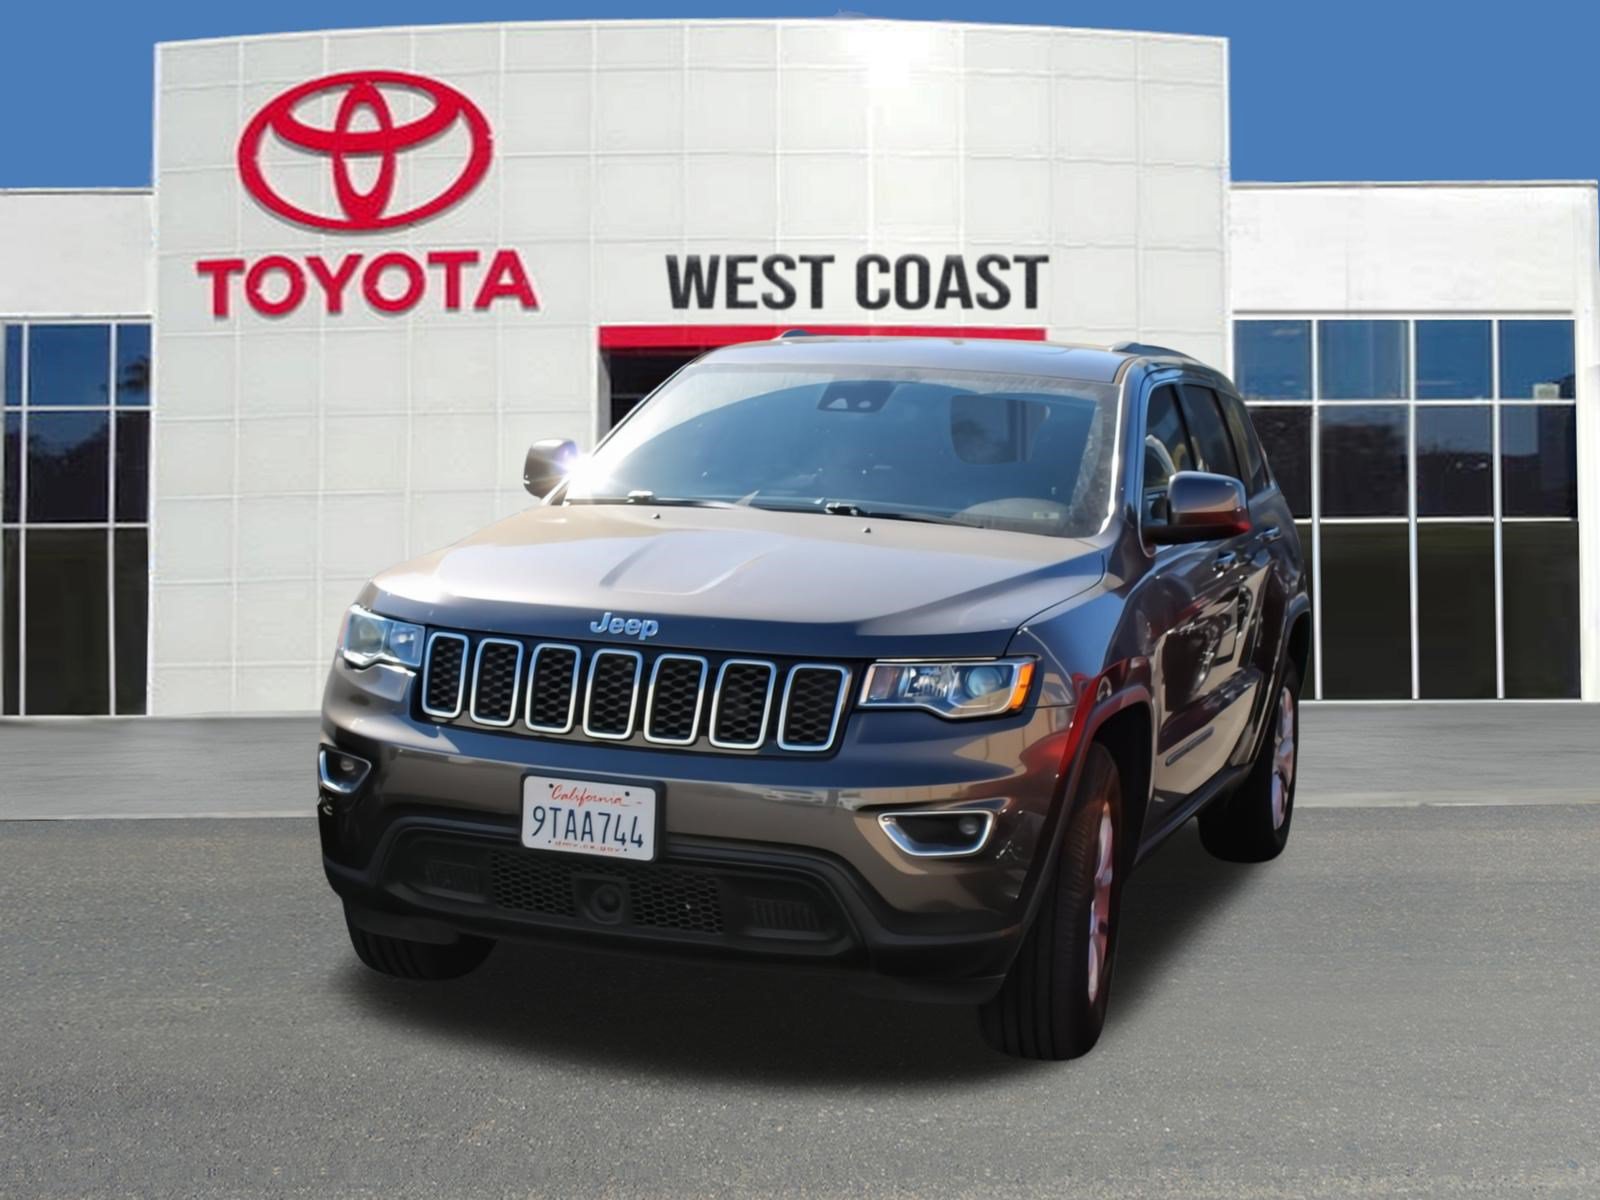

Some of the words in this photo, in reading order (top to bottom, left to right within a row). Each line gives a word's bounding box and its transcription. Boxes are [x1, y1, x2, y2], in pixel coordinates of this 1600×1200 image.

[196, 249, 539, 318] TOYOTA
[665, 253, 835, 310] WEST
[855, 253, 1049, 310] COAST
[590, 612, 659, 640] Jeep
[551, 784, 624, 807] California
[532, 805, 644, 849] 9TAA744
